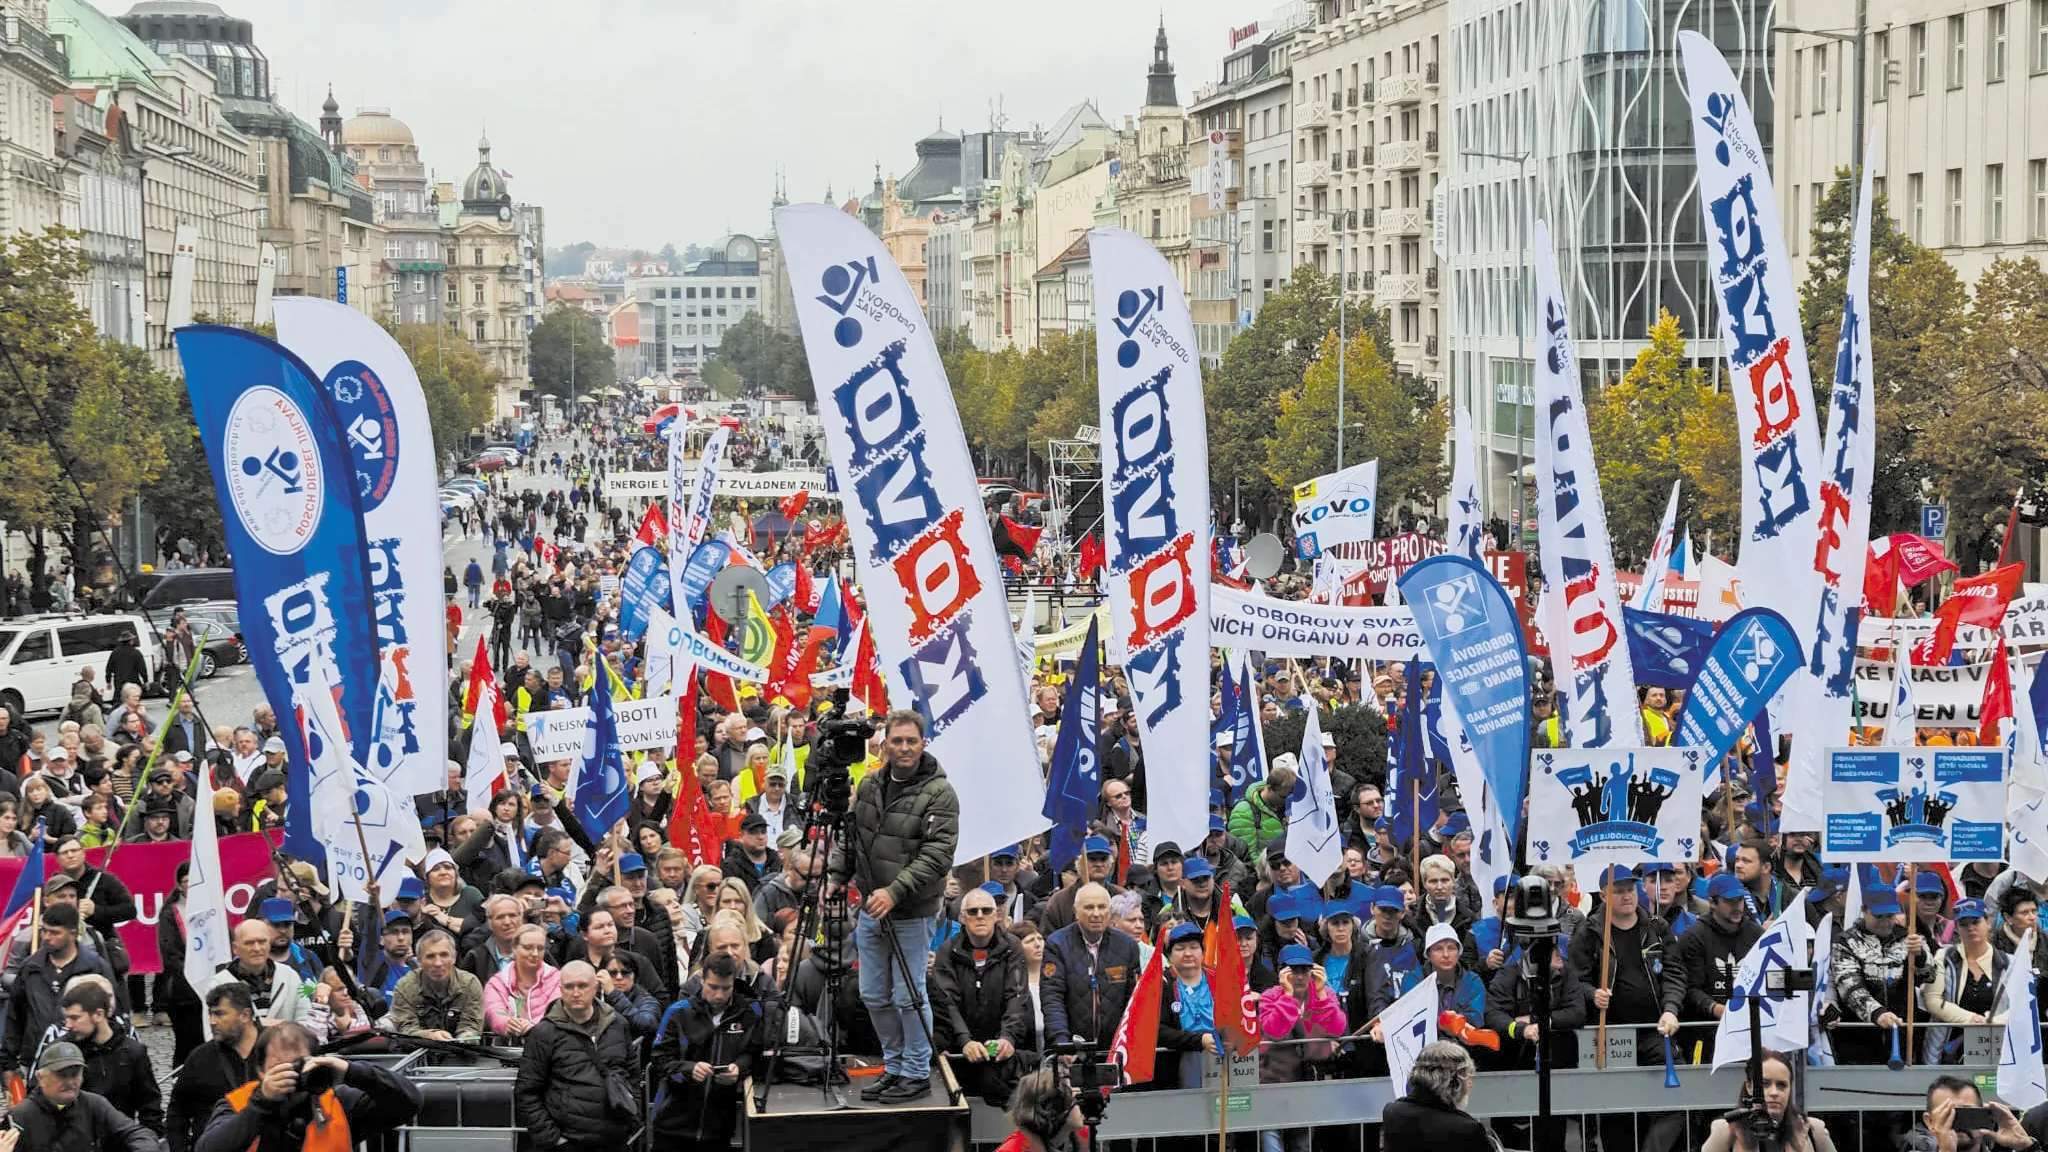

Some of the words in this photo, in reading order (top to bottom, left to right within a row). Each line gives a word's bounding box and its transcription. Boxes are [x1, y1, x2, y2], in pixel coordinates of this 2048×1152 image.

[1212, 149, 1222, 210] RAMADA
[1435, 194, 1444, 247] PRIMARK
[338, 270, 347, 303] ROKO
[610, 480, 659, 490] ENERGIE
[800, 480, 827, 492] ZIMU
[1296, 498, 1371, 529] KOVO
[1928, 509, 1942, 528] P
[1391, 533, 1420, 565] PRO
[1321, 580, 1367, 602] DADLA
[2005, 600, 2048, 620] SVA
[1356, 633, 1370, 647] A
[1706, 656, 1748, 710] ODBOROVÁ
[1691, 682, 1718, 718] BRANO
[1698, 669, 1745, 731] ORGANIZACE
[549, 719, 587, 732] NEJSM
[614, 706, 657, 725] OBOTI
[552, 741, 581, 755] LEVN
[655, 727, 678, 742] SÍLA
